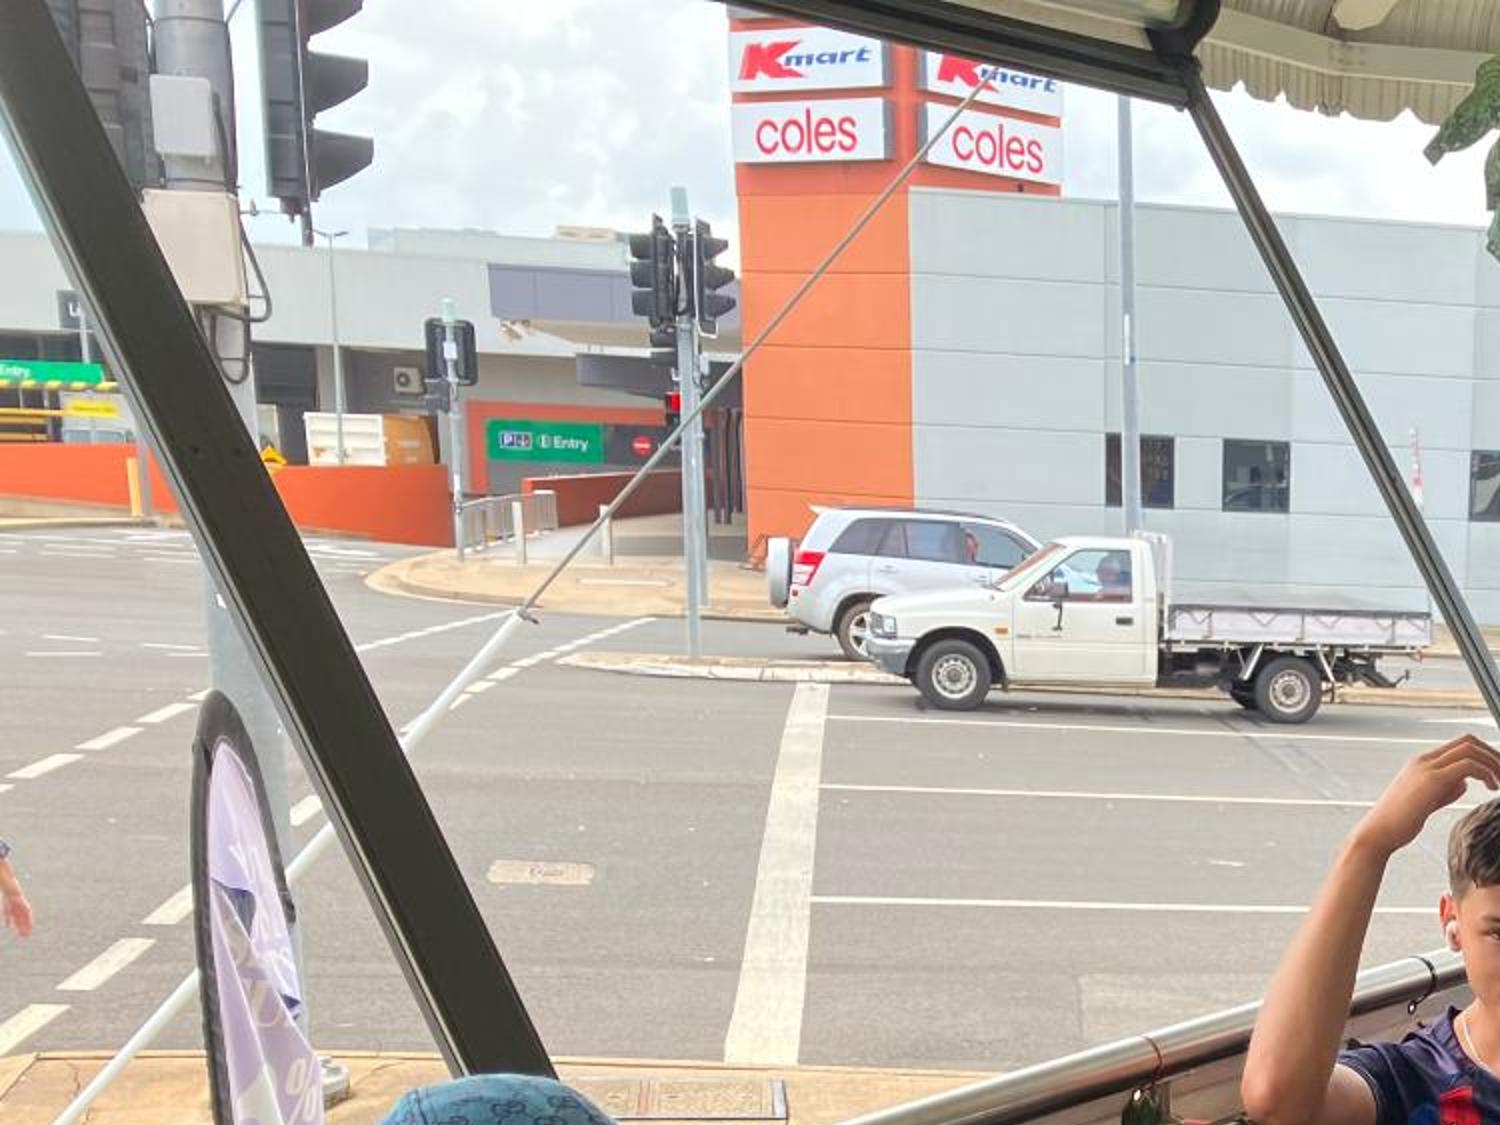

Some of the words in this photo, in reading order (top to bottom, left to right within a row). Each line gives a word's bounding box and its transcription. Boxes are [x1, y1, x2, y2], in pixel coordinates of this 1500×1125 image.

[738, 39, 873, 81] Kmart
[756, 107, 858, 155] coles
[952, 124, 1044, 174] coles
[553, 434, 589, 453] Entry
